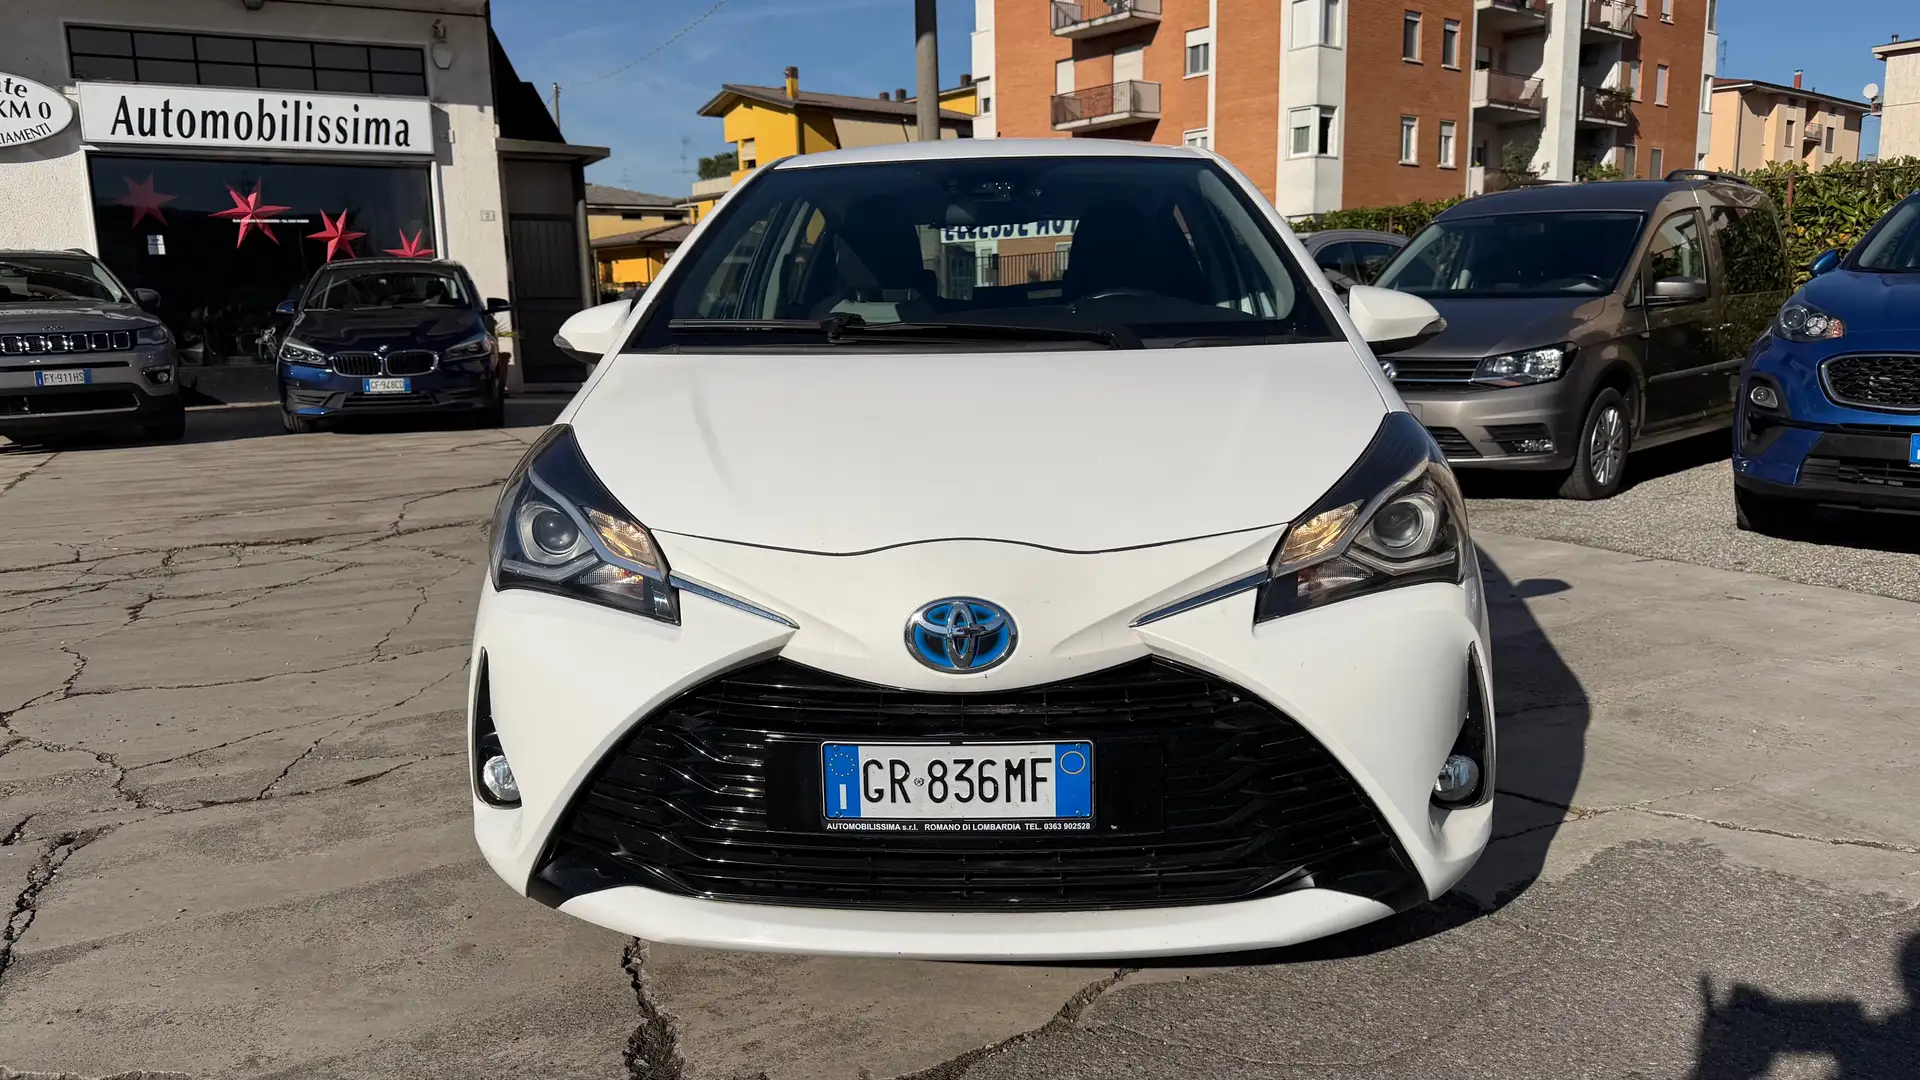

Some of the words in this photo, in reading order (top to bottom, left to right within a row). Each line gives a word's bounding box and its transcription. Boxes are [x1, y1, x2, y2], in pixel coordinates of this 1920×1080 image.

[0, 78, 28, 98] te
[110, 95, 411, 147] Automobilissima
[0, 122, 52, 144] IAMENTI
[826, 823, 901, 831] AUTOMOBILISSIMA
[902, 823, 919, 831] s.r.l.
[924, 823, 961, 831] ROMANO
[962, 823, 971, 831] DI
[972, 823, 1021, 831] LOMBARDIA
[1043, 822, 1062, 830] 0363
[1063, 822, 1091, 830] 902528
